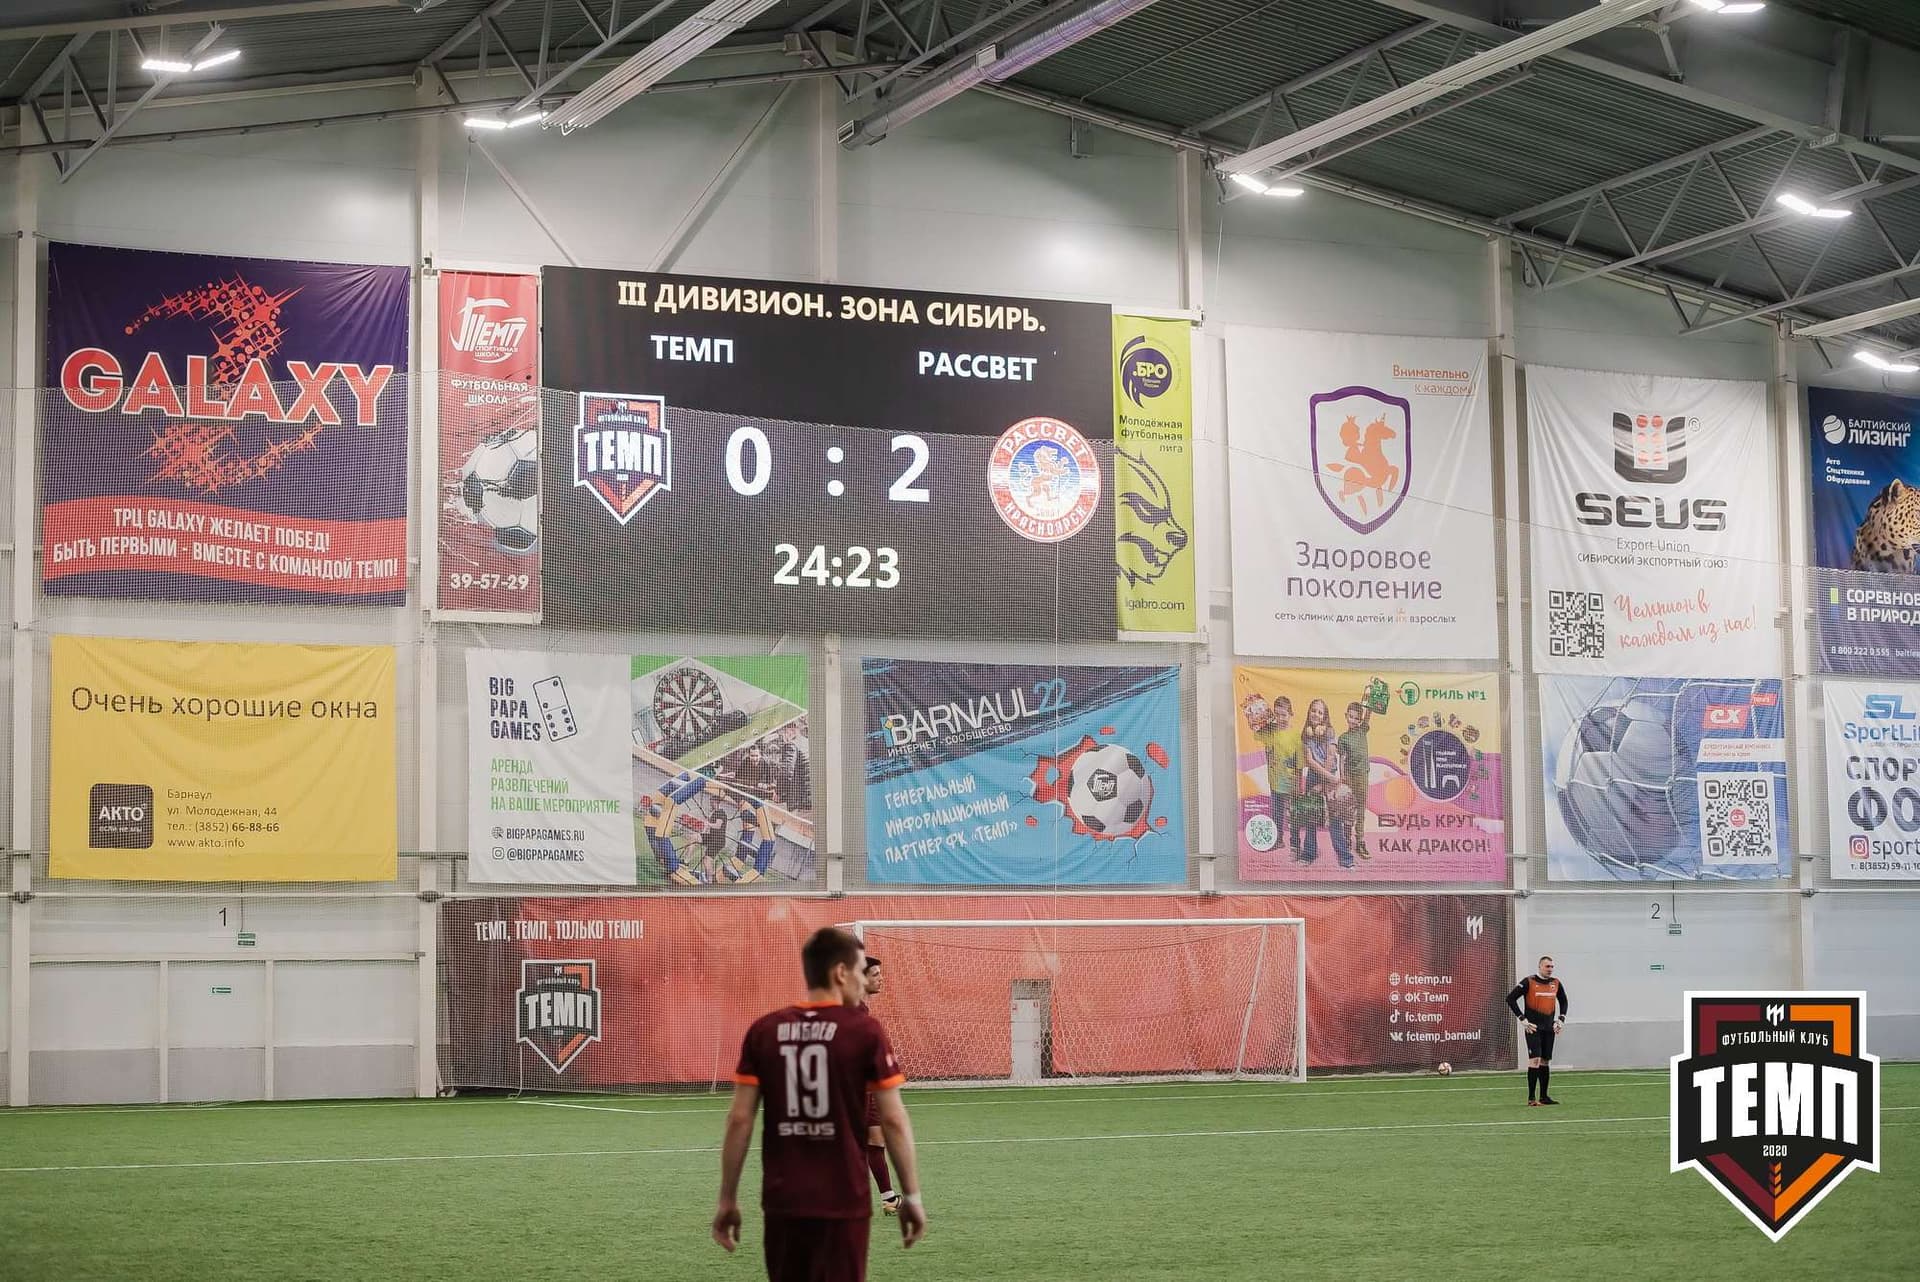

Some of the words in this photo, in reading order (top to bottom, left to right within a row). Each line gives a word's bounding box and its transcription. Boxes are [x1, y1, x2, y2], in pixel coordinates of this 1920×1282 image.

[618, 281, 647, 307] III
[654, 284, 833, 319] ДИВИЗИОН.
[840, 296, 919, 325] ЗОНА
[927, 302, 1046, 332] СИБИРЬ.
[650, 334, 734, 364] ТЕМП
[918, 350, 1037, 382] РАССВЕТ
[1393, 364, 1469, 379] Внимательно
[61, 348, 393, 426] GALAXY
[451, 380, 528, 391] ФУТБОЛЬНАЯ
[467, 394, 508, 404] ШКОЛА
[1121, 427, 1183, 441] футбольная
[1848, 419, 1911, 432] БАЛТИЙСКИЙ
[1001, 422, 1088, 457] РАССВЕТ
[1848, 429, 1911, 447] ЛИЗИНГ
[584, 430, 661, 476] ТЕМП
[725, 426, 772, 497] 0
[888, 435, 931, 503] 2
[1574, 491, 1728, 531] SEUS
[113, 508, 143, 528] ТРЦ
[148, 510, 206, 531] GALAXY
[209, 517, 271, 544] ЖЕЛАЕТ
[275, 525, 330, 552] ПОБЕД!
[1617, 537, 1654, 552] Export
[1657, 539, 1691, 552] Union
[53, 541, 96, 563] БЫТЬ
[100, 537, 177, 559] ПЕРВЫМИ
[194, 543, 250, 570] ВМЕСТЕ
[256, 552, 265, 570] С
[270, 553, 352, 581] КОМАНДОЙ
[356, 558, 399, 579] ТЕМП!
[1295, 541, 1431, 571] Здоровое
[1577, 551, 1635, 565] СИБИРСКИЙ
[1636, 555, 1702, 568] ЭКСПОРТНЫЙ
[1703, 559, 1729, 568] СОЮЗ
[774, 543, 900, 588] 24:23
[451, 574, 529, 590] 39-57-29
[1287, 577, 1442, 600] поколение
[1614, 593, 1696, 622] Чемпион
[1847, 607, 1857, 620] В
[1274, 613, 1296, 621] сеть
[1299, 613, 1335, 622] клиник
[1336, 614, 1354, 623] для
[1357, 613, 1385, 623] детей
[1410, 614, 1457, 625] взрослых
[1619, 620, 1696, 648] каждом
[1700, 622, 1719, 644] из
[489, 676, 514, 697] BIG
[1425, 689, 1464, 700] ГРИЛЬ
[71, 685, 163, 714] Очень
[172, 695, 301, 721] хорошие
[311, 700, 378, 719] окна
[489, 699, 529, 719] PAPA
[1864, 695, 1916, 719] SL
[490, 721, 541, 741] GAMES
[1844, 723, 1920, 743] SportLi
[887, 739, 938, 758] ИНТЕРНЕТ
[945, 723, 1012, 745] СООБЩЕСТВО
[490, 758, 534, 775] АРЕНДА
[1847, 756, 1920, 781] СПОР
[167, 789, 212, 800] Барнаул
[491, 777, 569, 794] РАЗВЛЕЧЕНИЙ
[884, 772, 977, 810] ГЕНЕРАЛЬНЫЙ
[99, 806, 144, 821] АКТО
[185, 806, 261, 817] Молодежная,
[264, 807, 277, 815] 44
[491, 796, 506, 811] НА
[509, 797, 541, 812] ВАШЕ
[543, 799, 621, 814] МЕРОПРИЯТИЕ
[885, 792, 1010, 838] ИНФОРМАЦИОННЫЙ
[1378, 814, 1431, 830] БУДЬ
[1436, 814, 1481, 831] КРУТ,
[195, 822, 229, 833] (3852)
[231, 822, 280, 832] 66-88-66
[506, 828, 585, 841] BIGPAPAGAMES.RU
[167, 837, 245, 848] www.akto.info
[885, 835, 943, 865] ПАРТНЕР
[945, 829, 968, 847] ФК
[971, 820, 1018, 844] «ТЕМП»
[1379, 839, 1413, 853] КАК
[1417, 838, 1491, 855] ДРАКОН!
[506, 848, 585, 861] @BIGPAPAGAMES
[219, 907, 226, 926] 1
[1651, 902, 1661, 919] 2
[474, 921, 511, 943] ТЕМП,
[514, 920, 552, 943] ТЕМП,
[555, 920, 604, 940] ТОЛЬКО
[607, 920, 644, 940] ТЕМП!
[1405, 975, 1452, 986] fctemp.ru
[1405, 993, 1421, 1002] ФК
[1422, 992, 1449, 1002] Темп
[525, 992, 593, 1030] ТЕМП
[1405, 1012, 1443, 1024] fc.temp
[1406, 1029, 1481, 1043] fctemp_barnaul
[780, 1043, 829, 1119] 19
[778, 1121, 836, 1136] SEUS
